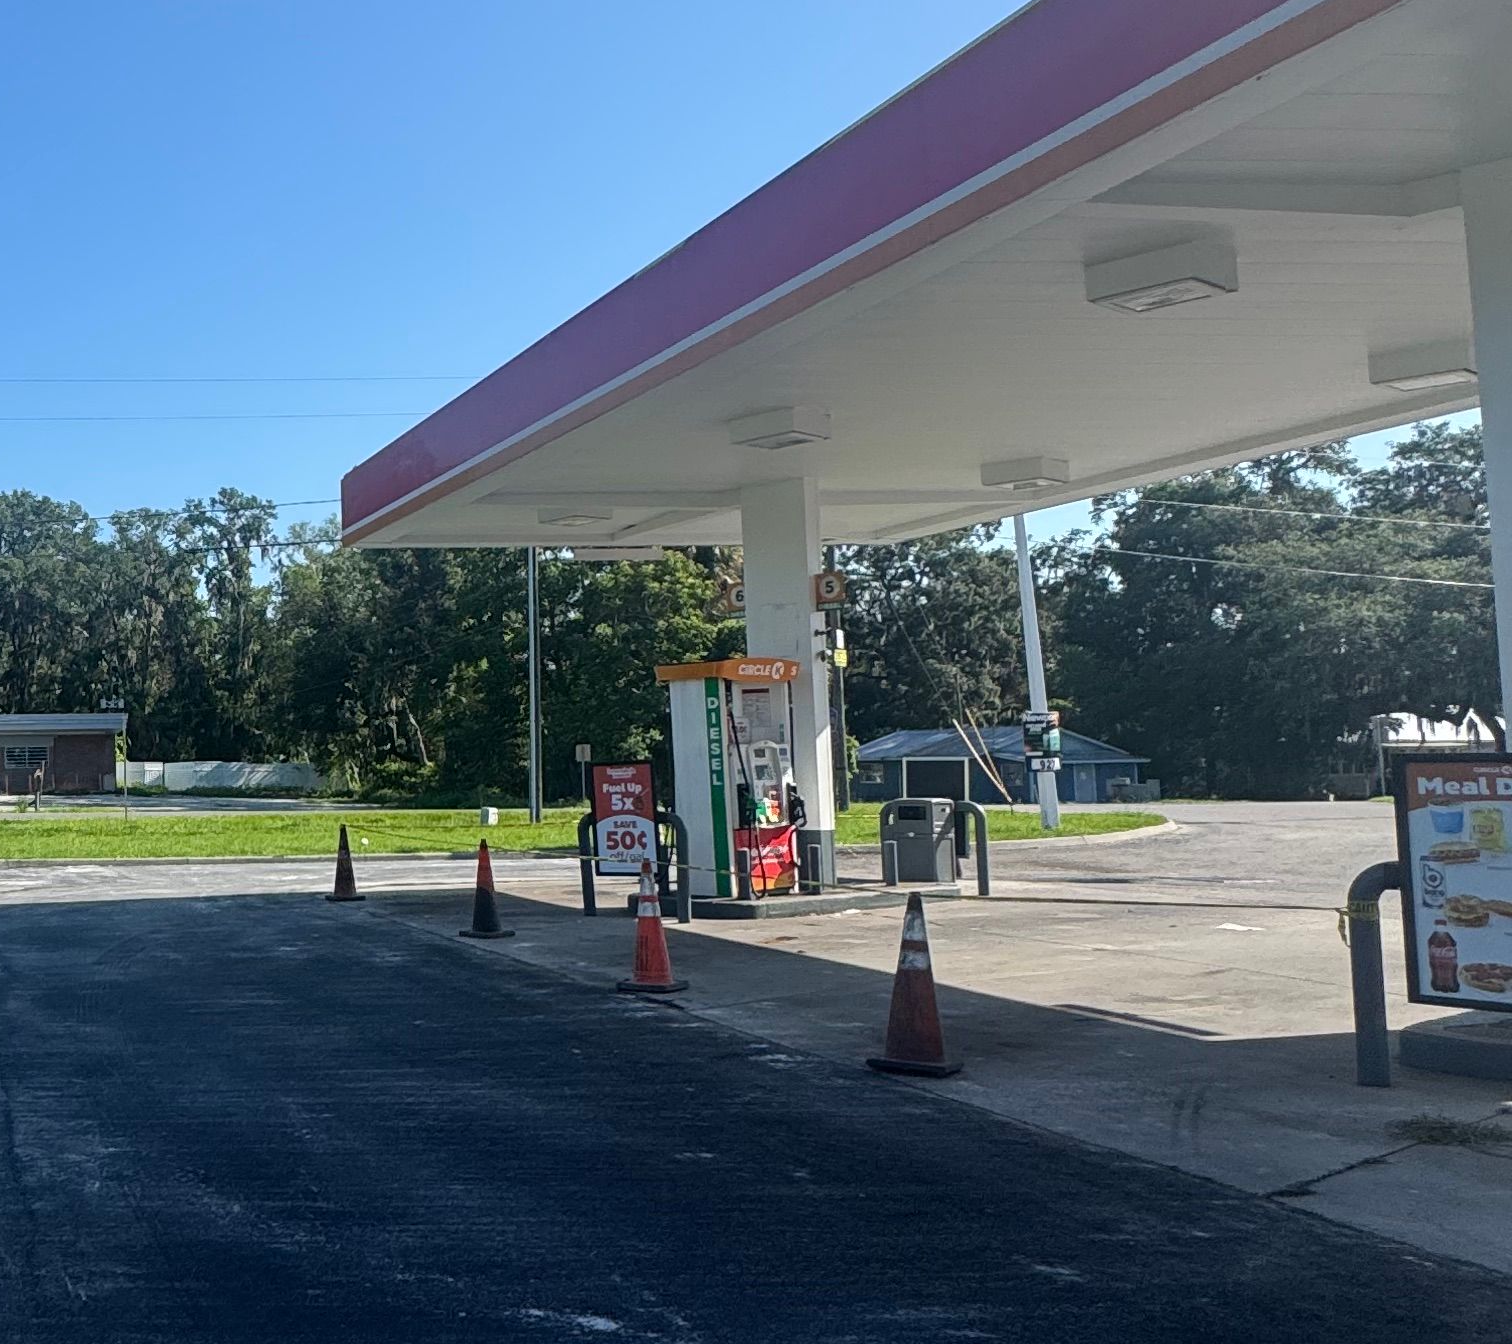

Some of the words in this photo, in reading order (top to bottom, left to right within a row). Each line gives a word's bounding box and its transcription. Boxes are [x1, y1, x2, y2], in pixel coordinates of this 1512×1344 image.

[824, 580, 835, 594] 5
[735, 589, 745, 603] 6
[738, 663, 772, 676] CIRCLE
[772, 661, 785, 680] K
[707, 696, 723, 786] DIESEL
[602, 784, 624, 794] Fuel
[627, 783, 642, 795] Up
[1416, 776, 1490, 795] Meal
[611, 794, 634, 811] 5x
[613, 820, 638, 829] SAVE
[606, 830, 648, 851] 50¢
